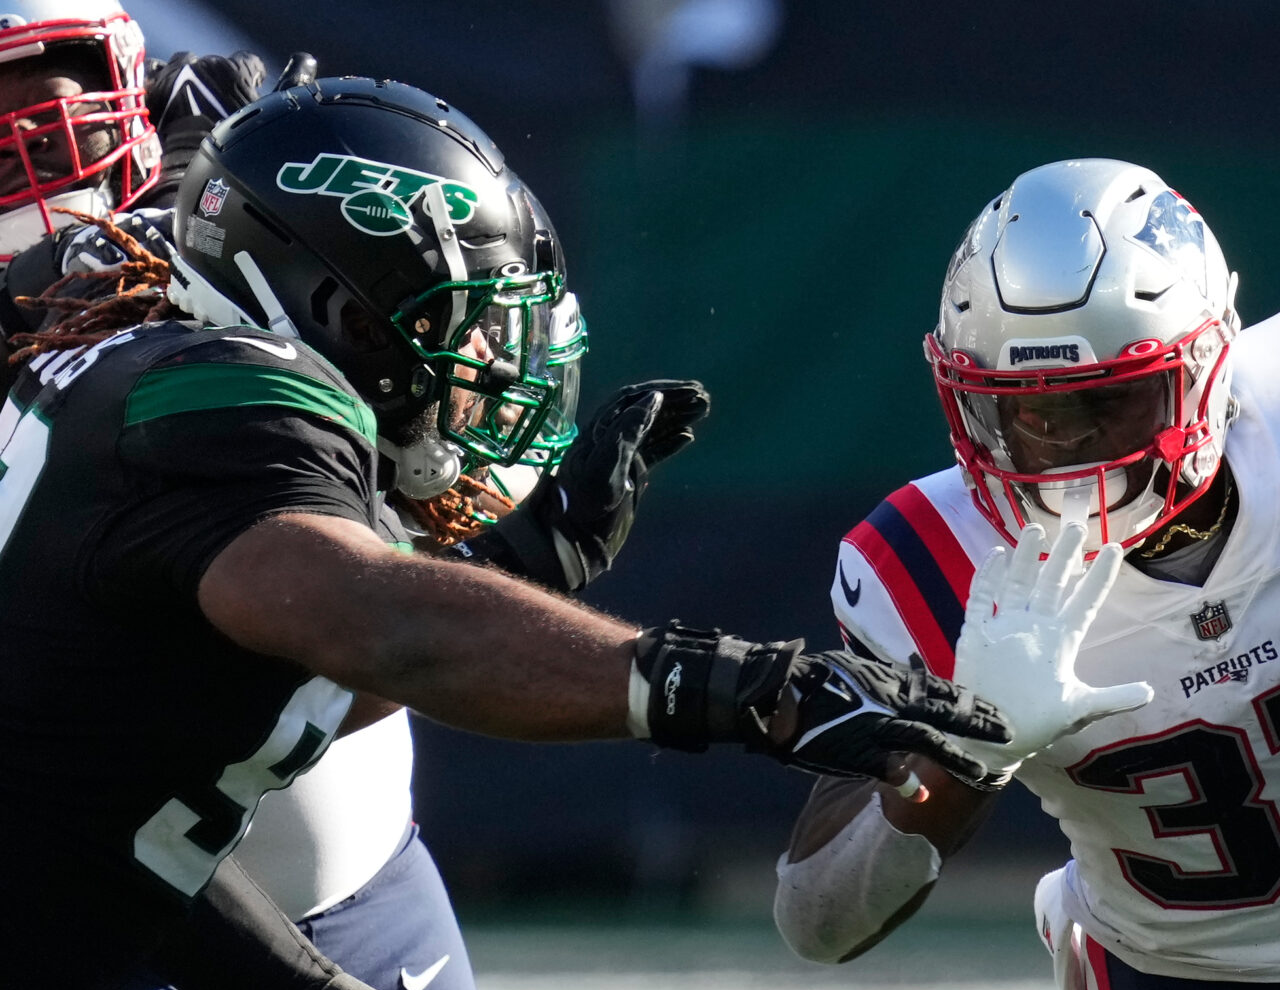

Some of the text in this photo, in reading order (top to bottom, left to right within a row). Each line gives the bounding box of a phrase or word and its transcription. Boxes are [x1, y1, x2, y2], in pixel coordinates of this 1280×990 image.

[276, 152, 481, 226] JETS
[1009, 344, 1080, 365] PATRIOTS
[1200, 617, 1228, 637] NFL
[1180, 640, 1279, 699] PATRIOTS
